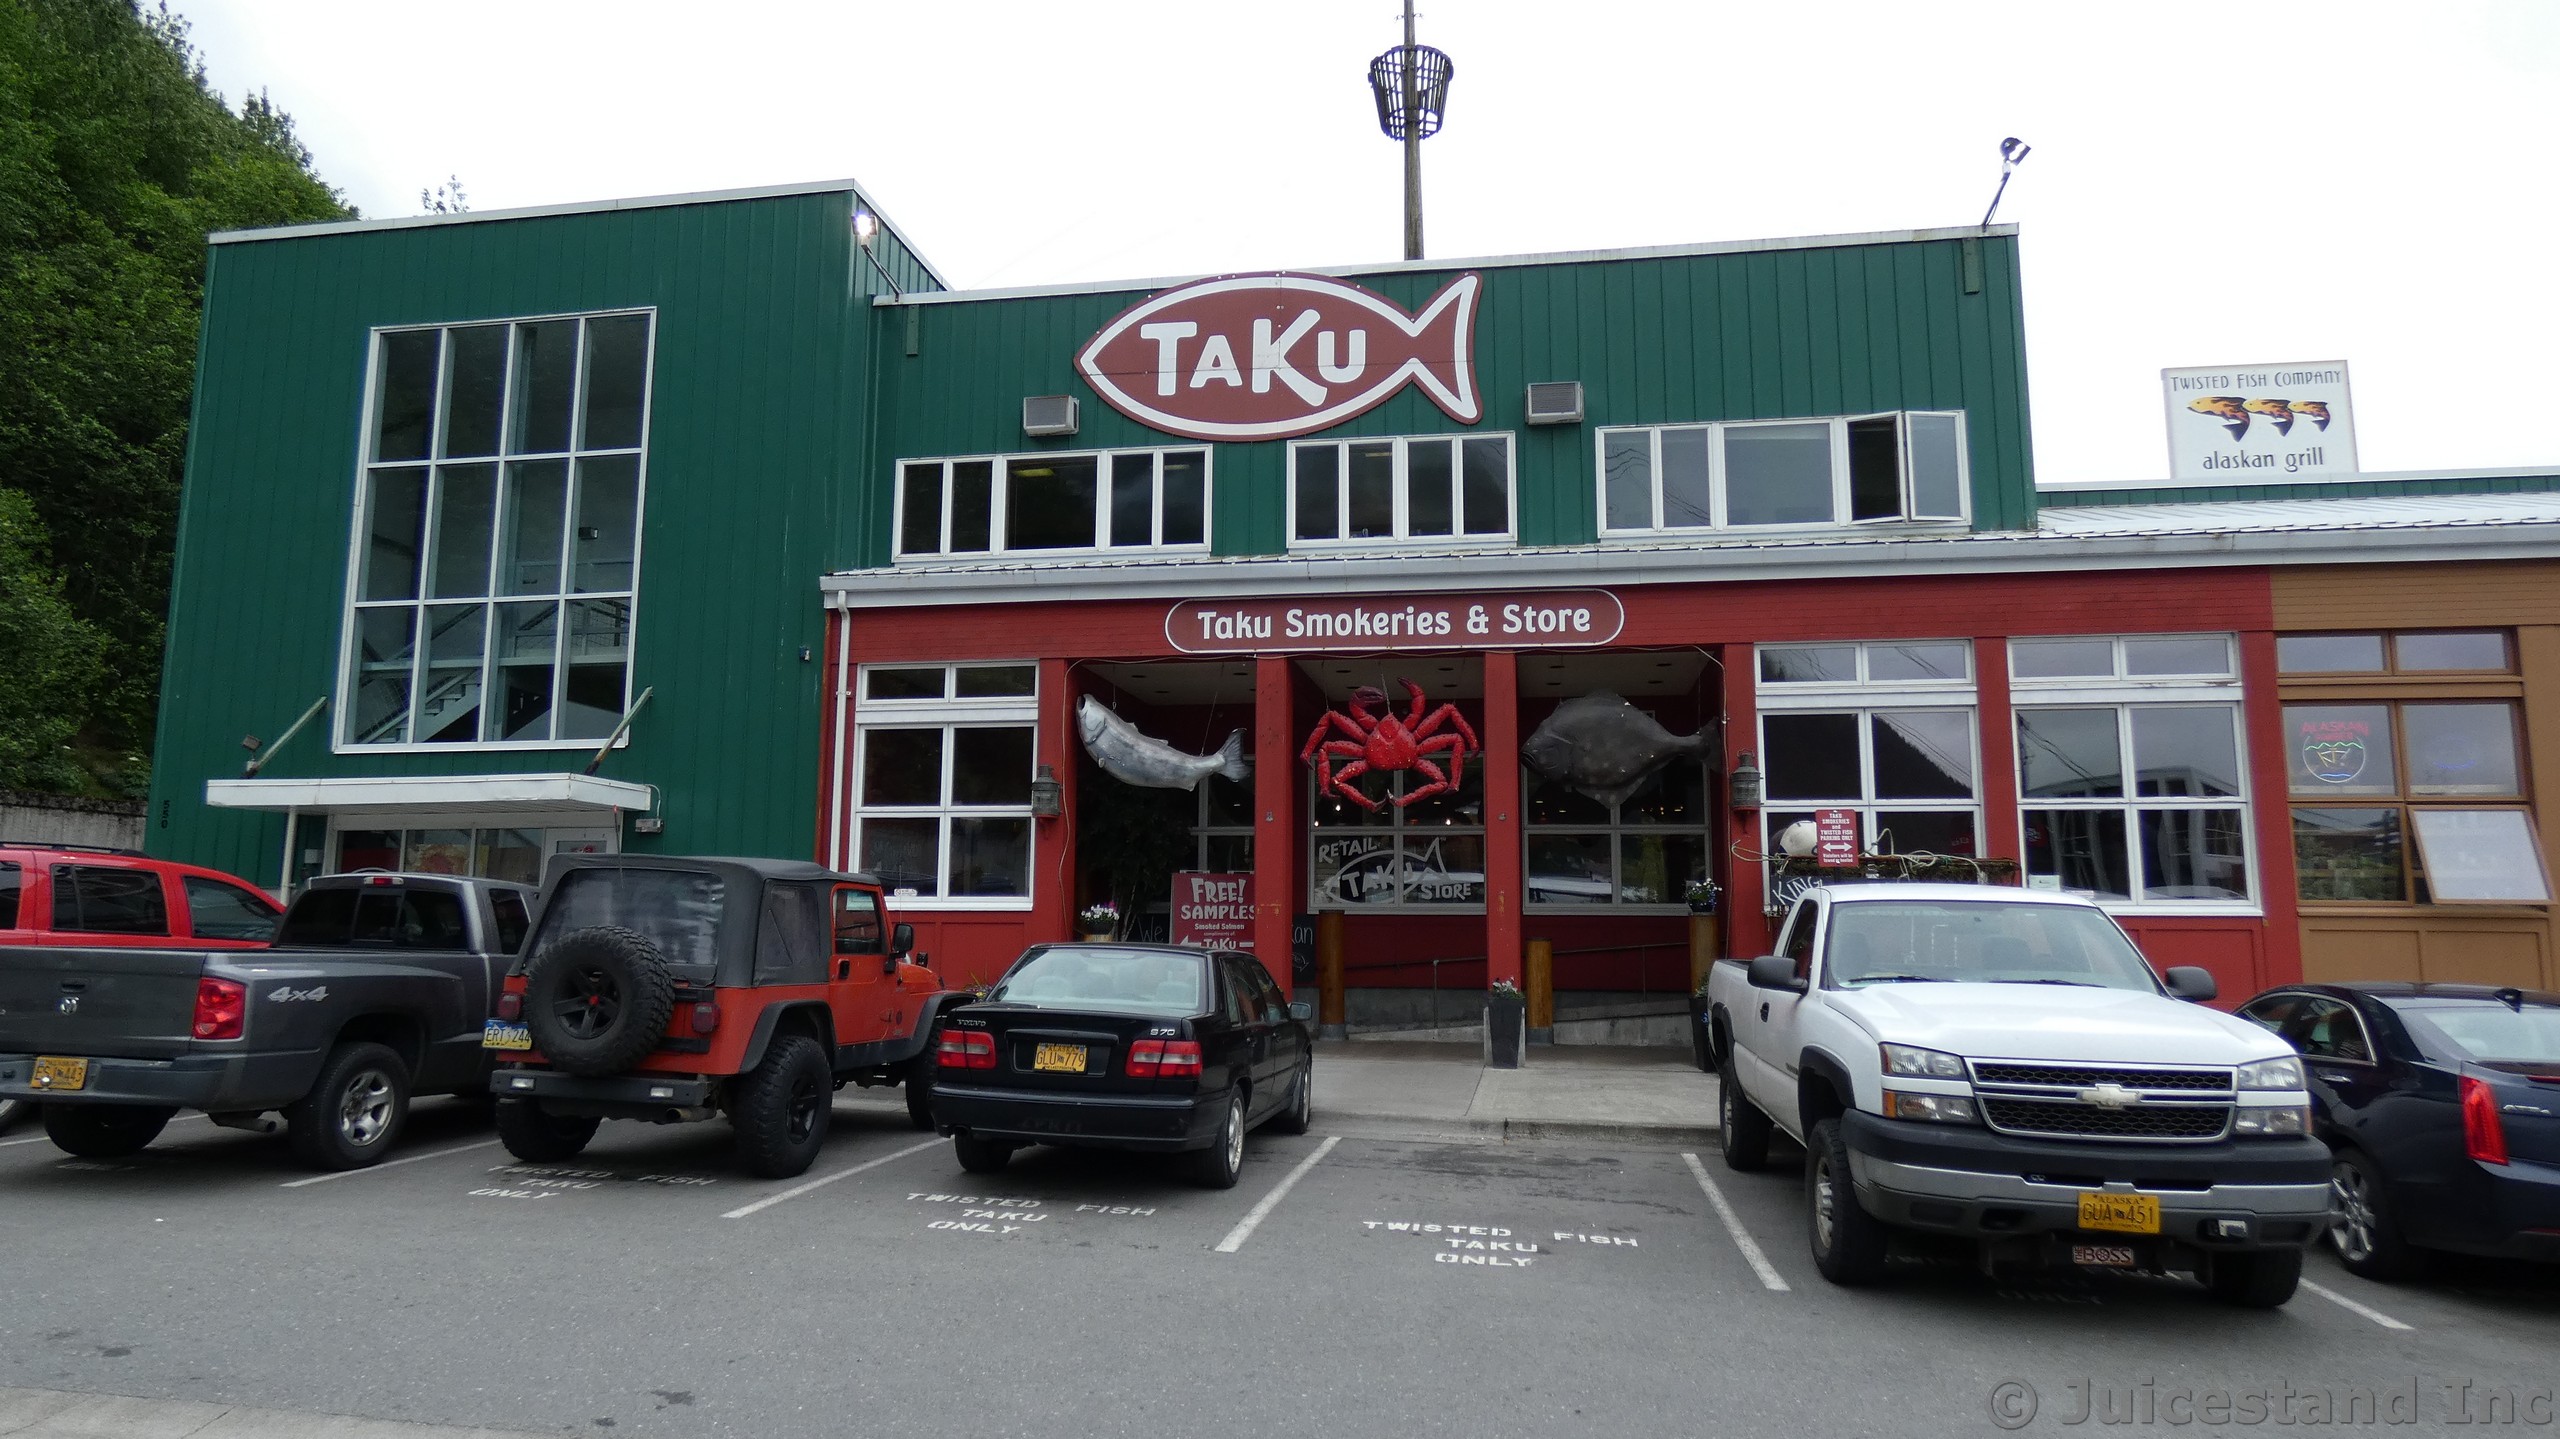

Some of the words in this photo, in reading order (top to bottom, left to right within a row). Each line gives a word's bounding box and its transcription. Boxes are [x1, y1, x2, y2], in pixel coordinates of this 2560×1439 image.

[1140, 308, 1366, 407] TAKU
[2170, 375, 2229, 392] TWISTED
[2237, 373, 2267, 389] FISH
[2274, 370, 2342, 387] COMPANY
[2202, 449, 2275, 470] alaskan
[2284, 446, 2324, 473] grill
[1197, 610, 1272, 640] Taku
[1285, 606, 1451, 638] Smokeries
[1466, 604, 1490, 635] &
[1502, 603, 1591, 634] Store
[1318, 837, 1378, 864] RETAIL
[1190, 877, 1247, 904] FREE!
[1420, 883, 1472, 901] STORE
[1194, 923, 1220, 931] Smoked
[1221, 923, 1245, 931] Salmon
[267, 985, 330, 1003] 4x4
[956, 1018, 987, 1027] VOLVO
[1036, 1050, 1057, 1066] GLU
[1064, 1052, 1085, 1067] 779
[467, 1187, 560, 1199] ONLY
[2100, 1196, 2140, 1206] ALASKA
[907, 1192, 1042, 1208] TWISTED
[1075, 1203, 1157, 1217] FISH
[2082, 1202, 2112, 1222] GUA
[2128, 1204, 2153, 1225] 451
[962, 1208, 1048, 1222] TAKU
[927, 1220, 1022, 1234] ONLY
[1362, 1220, 1512, 1237] TWISTED
[1553, 1231, 1639, 1247] FISH
[1445, 1238, 1538, 1253] TAKU
[1435, 1252, 1534, 1267] ONLY
[2083, 1247, 2131, 1263] BOSS
